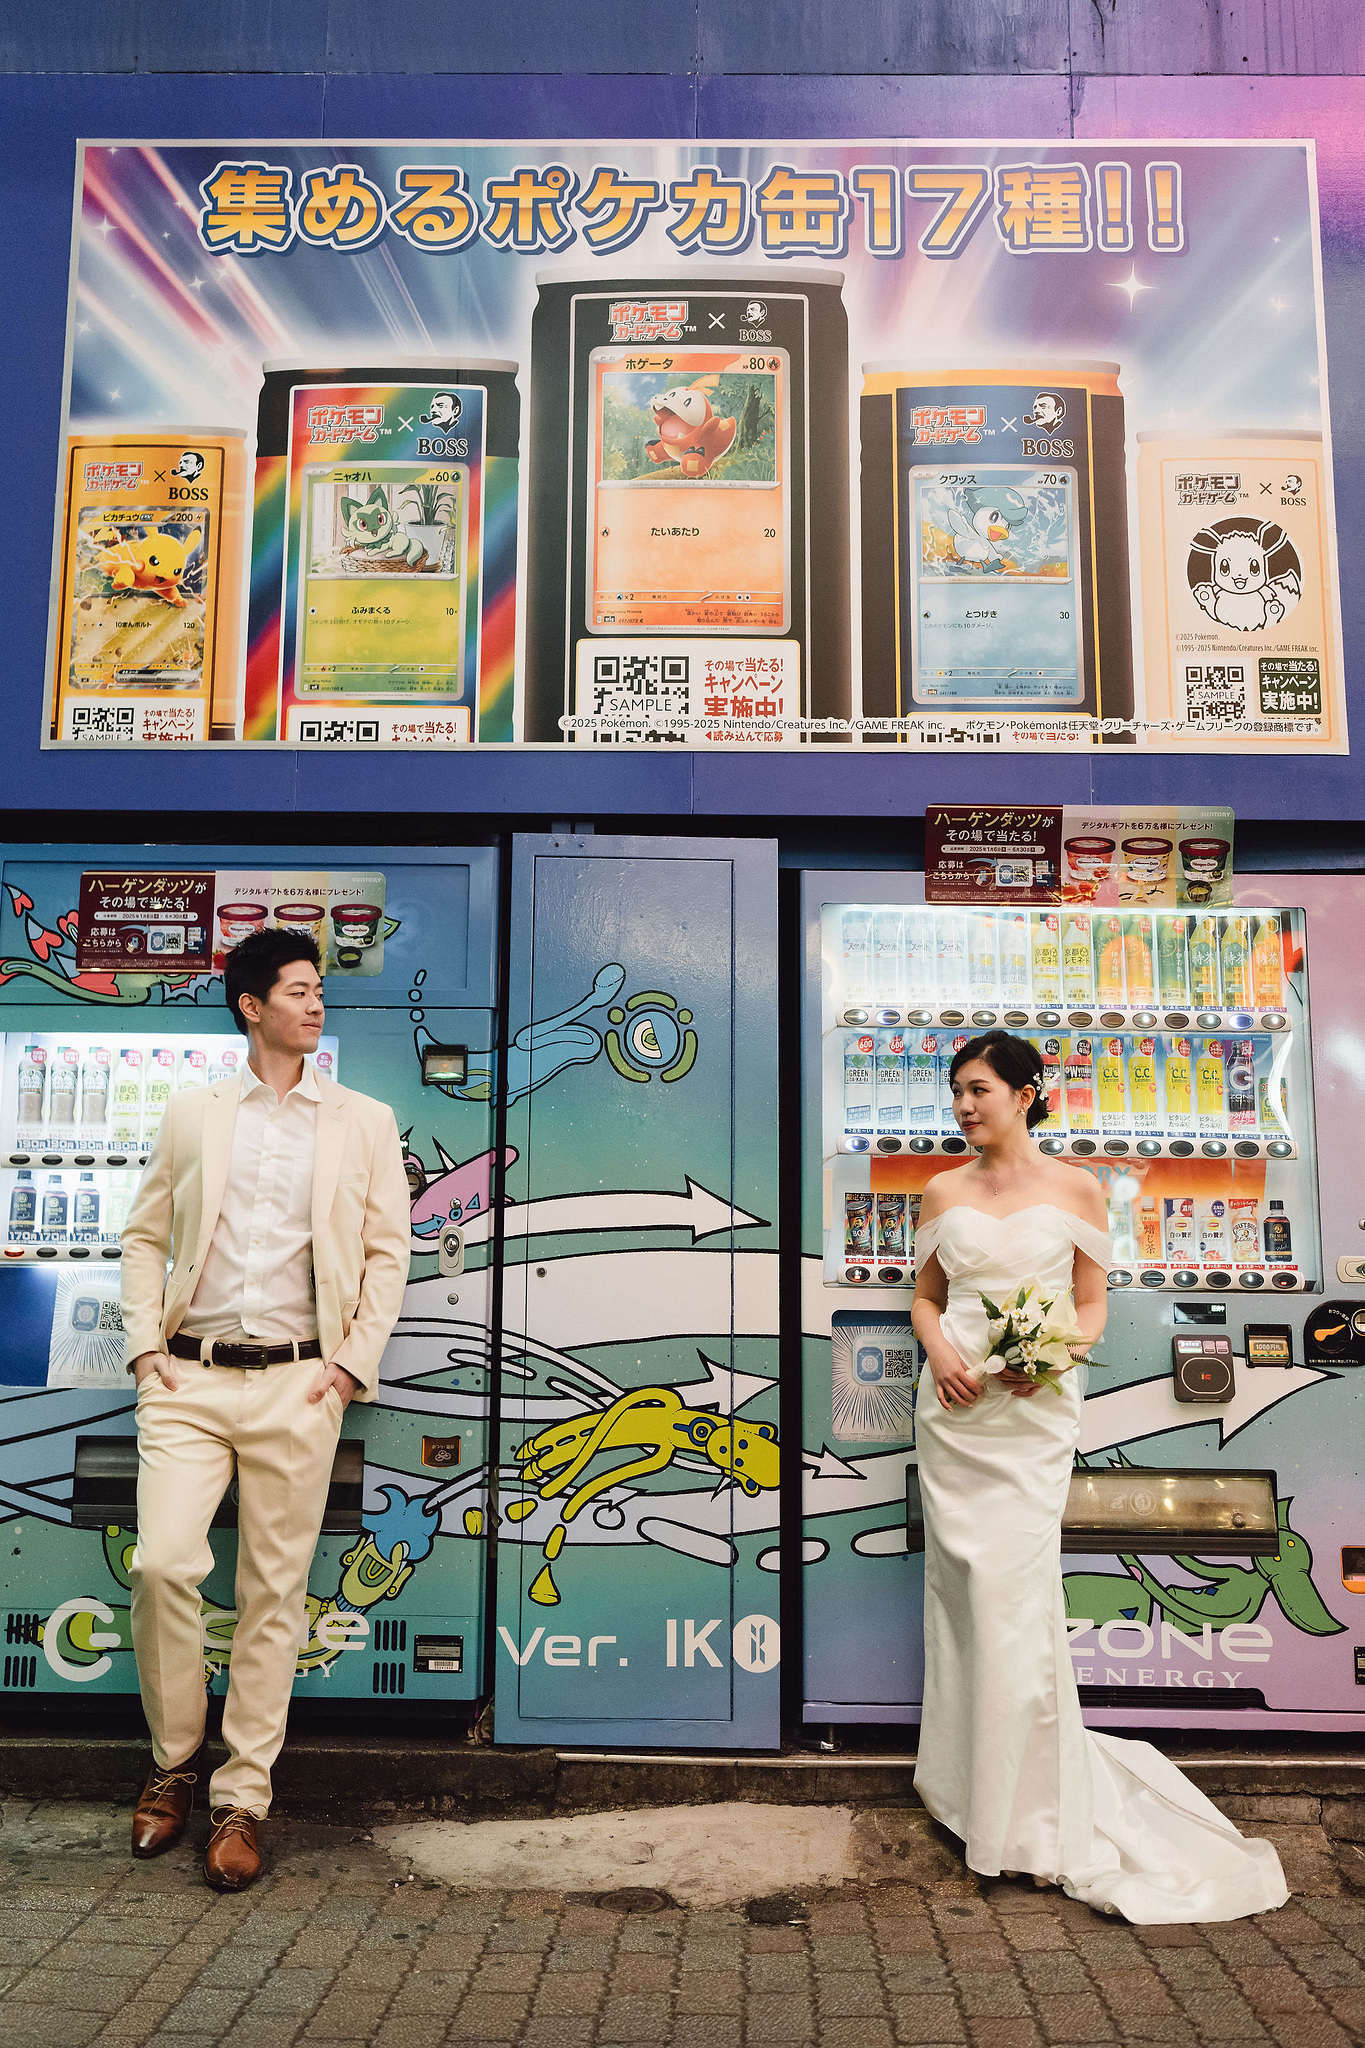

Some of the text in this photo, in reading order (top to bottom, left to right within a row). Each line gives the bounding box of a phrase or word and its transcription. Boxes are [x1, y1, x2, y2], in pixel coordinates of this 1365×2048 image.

[202, 164, 1184, 252] 集めるポケカ缶17種!!
[609, 301, 688, 324] ポケモン
[611, 324, 684, 341] カードゲーム
[739, 329, 772, 342] BOSS
[625, 357, 765, 371] ホゲータ 80
[308, 406, 384, 427] ポケモン
[911, 405, 987, 427] ポケモン
[310, 427, 378, 444] カードゲーム
[912, 427, 982, 445] カードゲーム
[417, 438, 468, 456] BOSS
[1022, 438, 1074, 457] BOSS
[84, 462, 143, 478] ポケモン
[333, 472, 371, 481] ニャオハ
[86, 478, 138, 491] カードゲーム
[939, 475, 977, 485] クワッス
[1175, 473, 1241, 491] ポケモン
[168, 487, 209, 500] BOSS
[1178, 491, 1237, 505] カードゲーム
[1280, 497, 1307, 506] BOSS
[176, 513, 193, 522] 200
[650, 527, 700, 537] たいあたり
[764, 528, 776, 538] 20
[351, 606, 391, 615] ふみまくる
[965, 610, 998, 619] とつげき
[1059, 611, 1070, 620] 30
[183, 621, 195, 629] 120
[704, 657, 784, 673] その場で当たる!
[1260, 660, 1318, 672] その場で当たる!
[704, 673, 784, 694] キャンペーン
[1261, 675, 1318, 690] キャンペーン
[1197, 691, 1236, 700] SAMPLE
[1262, 690, 1318, 711] 実施中!
[609, 698, 673, 712] SAMPLE
[704, 695, 784, 718] 実施中!
[143, 707, 195, 718] その場で当たる!
[142, 719, 194, 731] キャンペーン
[391, 721, 457, 734] その場で当たる!
[562, 718, 597, 729] ©2025
[600, 717, 650, 729] Pokémon.
[654, 718, 720, 730] ©1995-2025
[723, 718, 826, 732] Nintendo/Creatures
[829, 720, 847, 730] Inc.
[891, 720, 924, 730] FREAK
[927, 720, 946, 730] inc.
[713, 731, 784, 742] 読み込んで応募
[933, 811, 1055, 828] ハーゲンダッツが
[1081, 821, 1213, 831] デジタルギフトを6万名様にプレゼント!
[945, 829, 1037, 842] その場で当たる!
[937, 860, 964, 869] 応募は
[932, 871, 970, 881] こちらから
[88, 877, 207, 895] ハーゲンダッツが
[234, 887, 365, 896] デジタルギフトを6万名様にプレゼント!
[99, 896, 190, 909] その場で当たる!
[90, 927, 117, 937] 応募は
[82, 938, 122, 948] こちらから
[1035, 956, 1058, 965] レモネード
[1065, 956, 1090, 965] レモネード
[1192, 951, 1215, 965] 特茶
[1224, 951, 1247, 965] 特茶
[1255, 951, 1279, 965] 特茶
[859, 1041, 872, 1049] 600
[848, 1069, 869, 1077] GREEN
[880, 1070, 900, 1078] GREEN
[912, 1069, 932, 1077] GREEN
[102, 1232, 120, 1241] 150
[497, 1626, 628, 1667] Ver.
[1077, 1666, 1243, 1689] ENERGY
